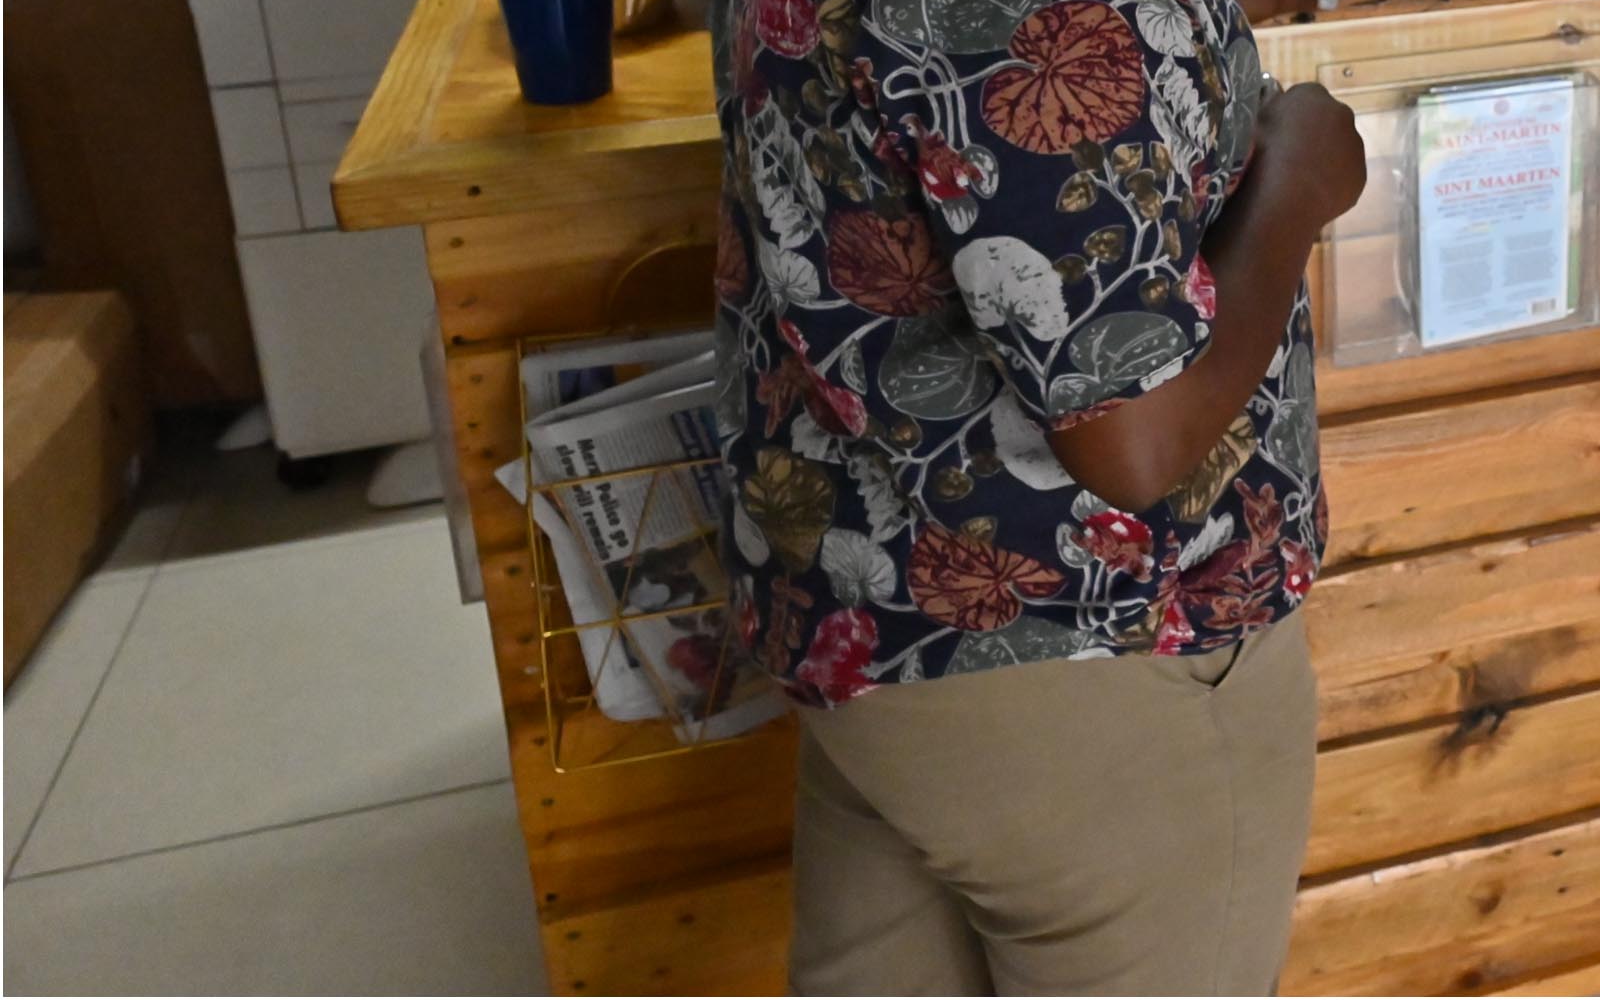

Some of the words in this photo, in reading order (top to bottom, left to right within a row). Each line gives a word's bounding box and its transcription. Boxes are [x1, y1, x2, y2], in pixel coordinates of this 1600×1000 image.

[1433, 180, 1472, 198] SINT
[1477, 167, 1561, 190] MAARTEN
[595, 482, 621, 526] Police
